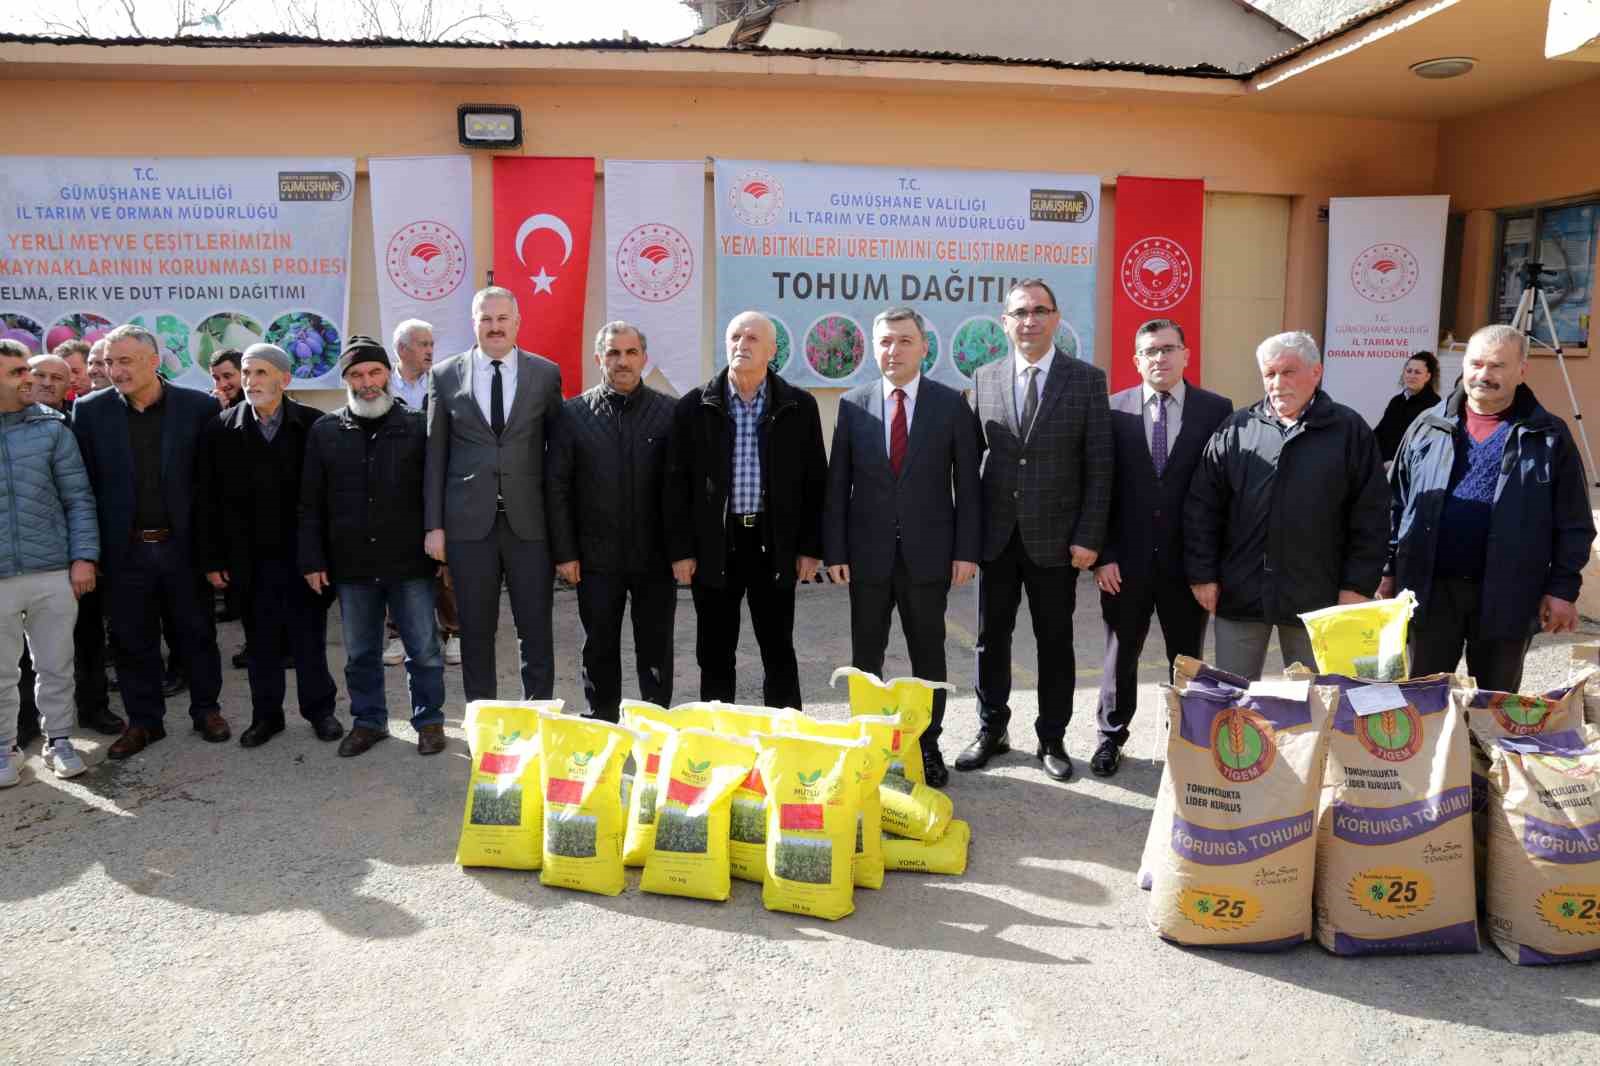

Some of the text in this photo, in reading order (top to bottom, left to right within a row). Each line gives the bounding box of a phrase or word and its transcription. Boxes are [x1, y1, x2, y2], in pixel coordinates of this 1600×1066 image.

[133, 167, 159, 181] T.C.
[898, 177, 920, 190] T.C.
[60, 184, 232, 203] GÜMÜŞHANE VALİLİĞİ
[830, 191, 986, 211] GÜMÜŞHANE VALİLİĞİ
[17, 203, 279, 220] İL TARIM VE ORMAN MÜDÜRLÜĞÜ
[1032, 199, 1084, 212] GÜMÜŞHANE
[788, 211, 1026, 231] İL TARIM VE ORMAN MÜDÜRLÜĞÜ
[70, 233, 137, 250] MEYVE
[720, 235, 757, 256] YEM
[0, 257, 154, 276] KAYNAKLARININ
[159, 257, 267, 275] KORUNMASI
[1, 283, 305, 301] ELMA, ERİK VE DUT FİDANI DAĞITIMI
[772, 268, 1043, 303] TOHUM DAĞITI
[1364, 337, 1394, 346] TARIM
[1395, 337, 1408, 346] VE
[1327, 350, 1365, 358] ORMAN
[880, 815, 910, 829] OHUMU
[1337, 793, 1473, 836] KORUNGA TOHUMU
[1174, 818, 1312, 856] KORUNGA TOHUMU
[1528, 831, 1600, 855] KORUNG
[1578, 899, 1600, 920] 2
